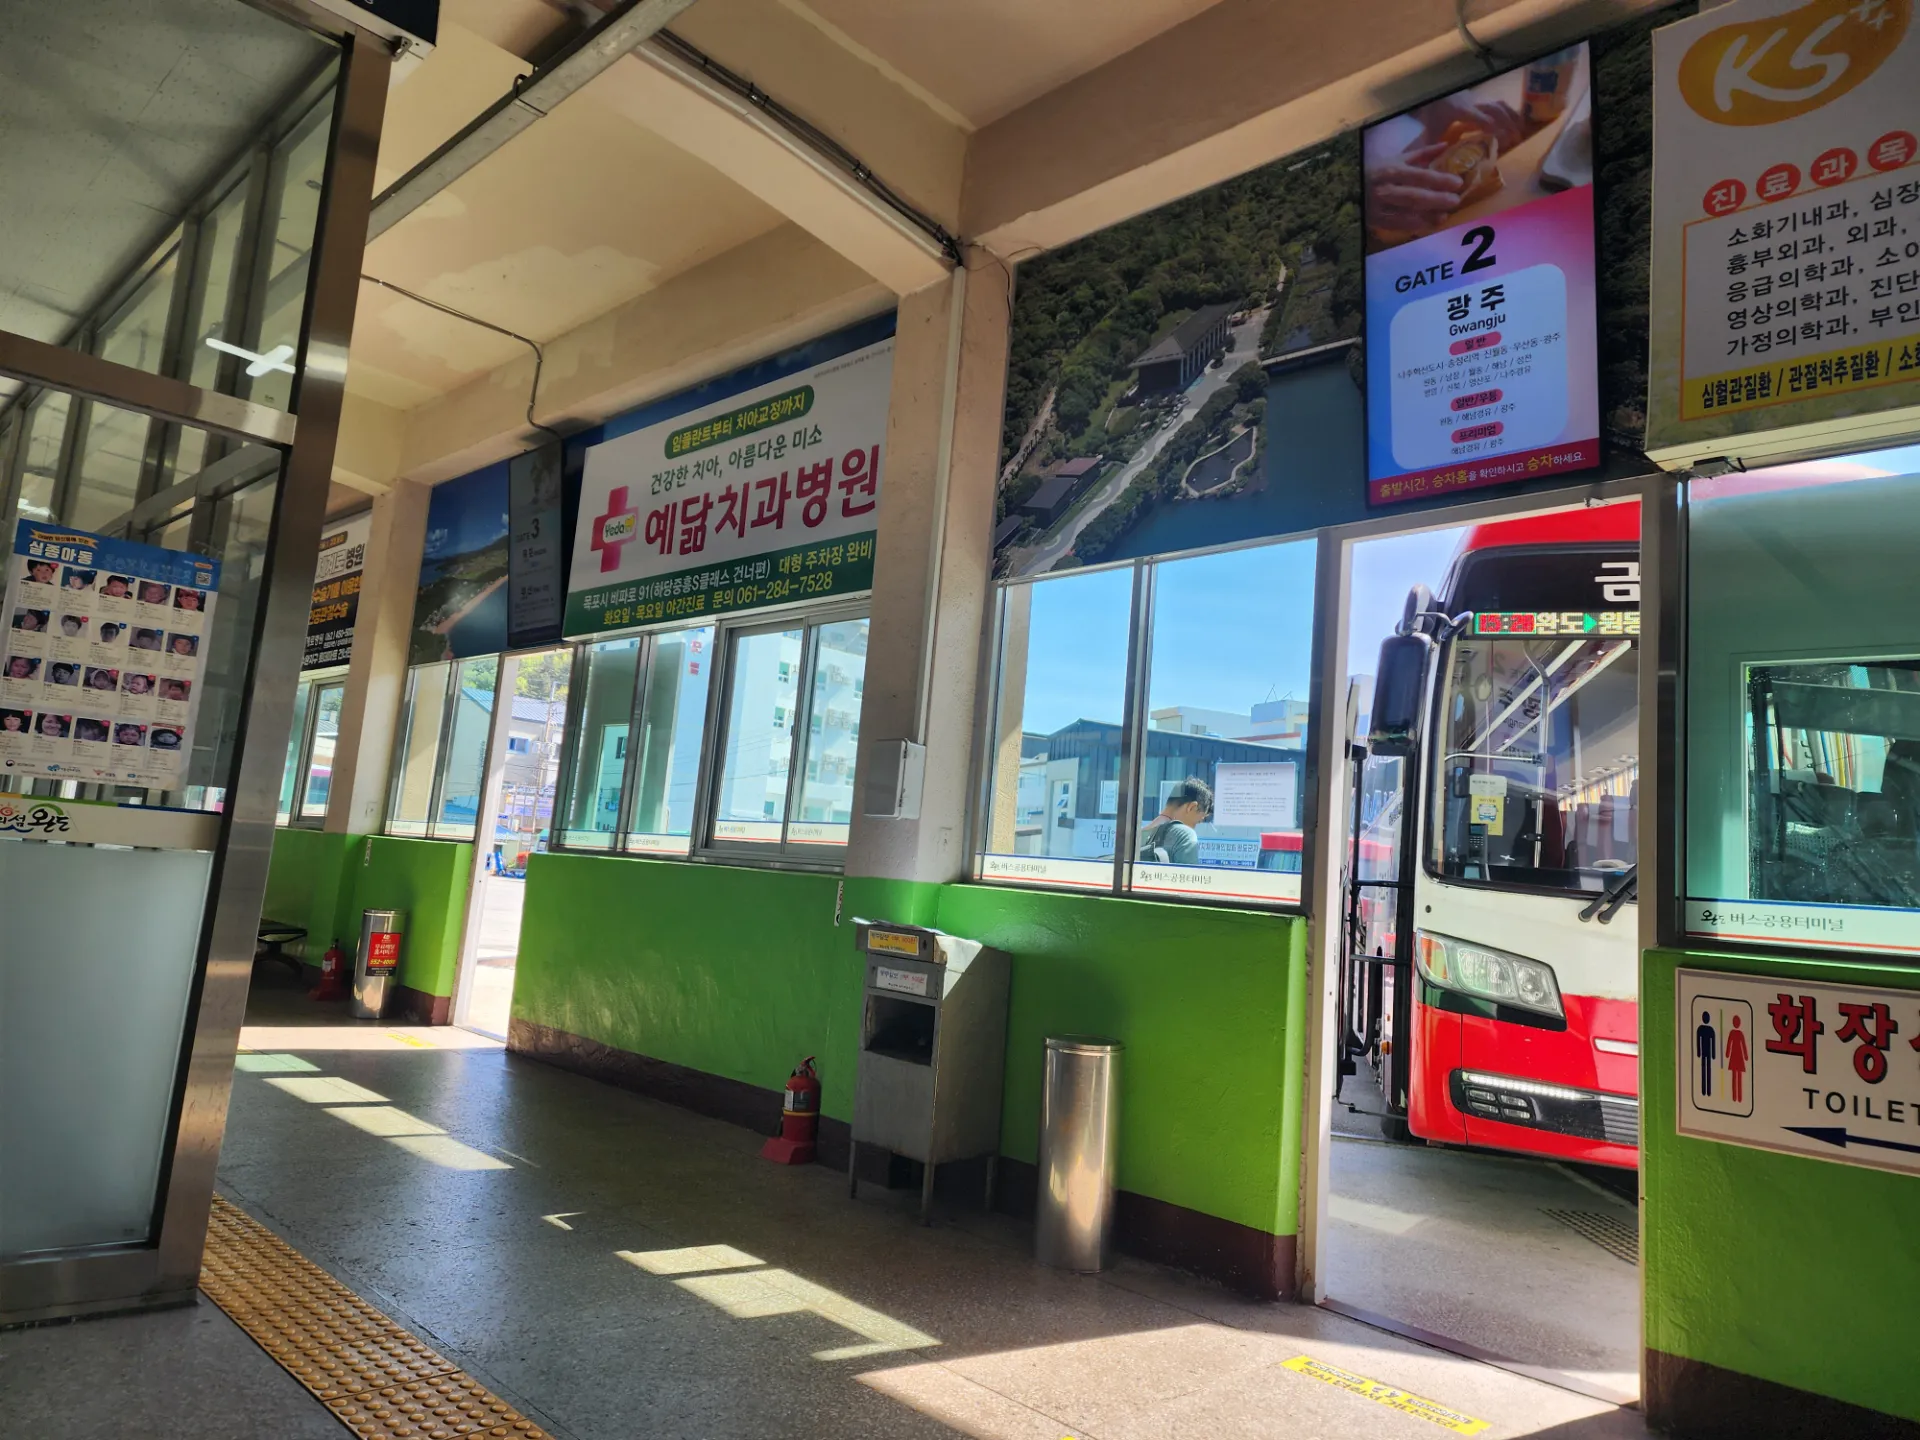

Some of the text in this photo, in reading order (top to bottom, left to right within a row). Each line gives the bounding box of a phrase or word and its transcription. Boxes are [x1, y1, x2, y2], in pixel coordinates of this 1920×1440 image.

[1727, 200, 1859, 247] 소화기내과,
[1727, 217, 1907, 275] 흉부외과, 외과,
[1395, 225, 1497, 293] GATE 2
[1727, 256, 1865, 302] 응급의학과,
[1449, 313, 1506, 336] Gwangju
[1727, 286, 1858, 330] 영상의학과,
[1727, 315, 1859, 356] 가정의학과,
[1701, 371, 1773, 409] 심혈관질환
[1788, 350, 1880, 392] 관절척추질환
[671, 391, 806, 453] 임플란트부터 치아교정까지
[1458, 425, 1498, 441] 프리미엄
[651, 424, 823, 496] 건강한 치아, 아름다운 미소
[1380, 451, 1586, 499] 출발시간, 승차홈을 확인하시고 승차하세요.
[645, 445, 880, 556] 예닮치과병원
[531, 518, 540, 539] 3
[29, 541, 93, 565] 실종아동
[778, 538, 873, 576] 대형 주차장 완비
[583, 594, 610, 611] 목포시
[611, 590, 637, 607] 비파로
[733, 559, 771, 585] 건너편)
[665, 594, 705, 617] 야간진료
[712, 589, 734, 611] 문의
[737, 571, 834, 605] 061-284-7528
[1536, 611, 1584, 635] 완도
[1730, 913, 1844, 932] 버스공용터미널
[1766, 993, 1920, 1085] 화장
